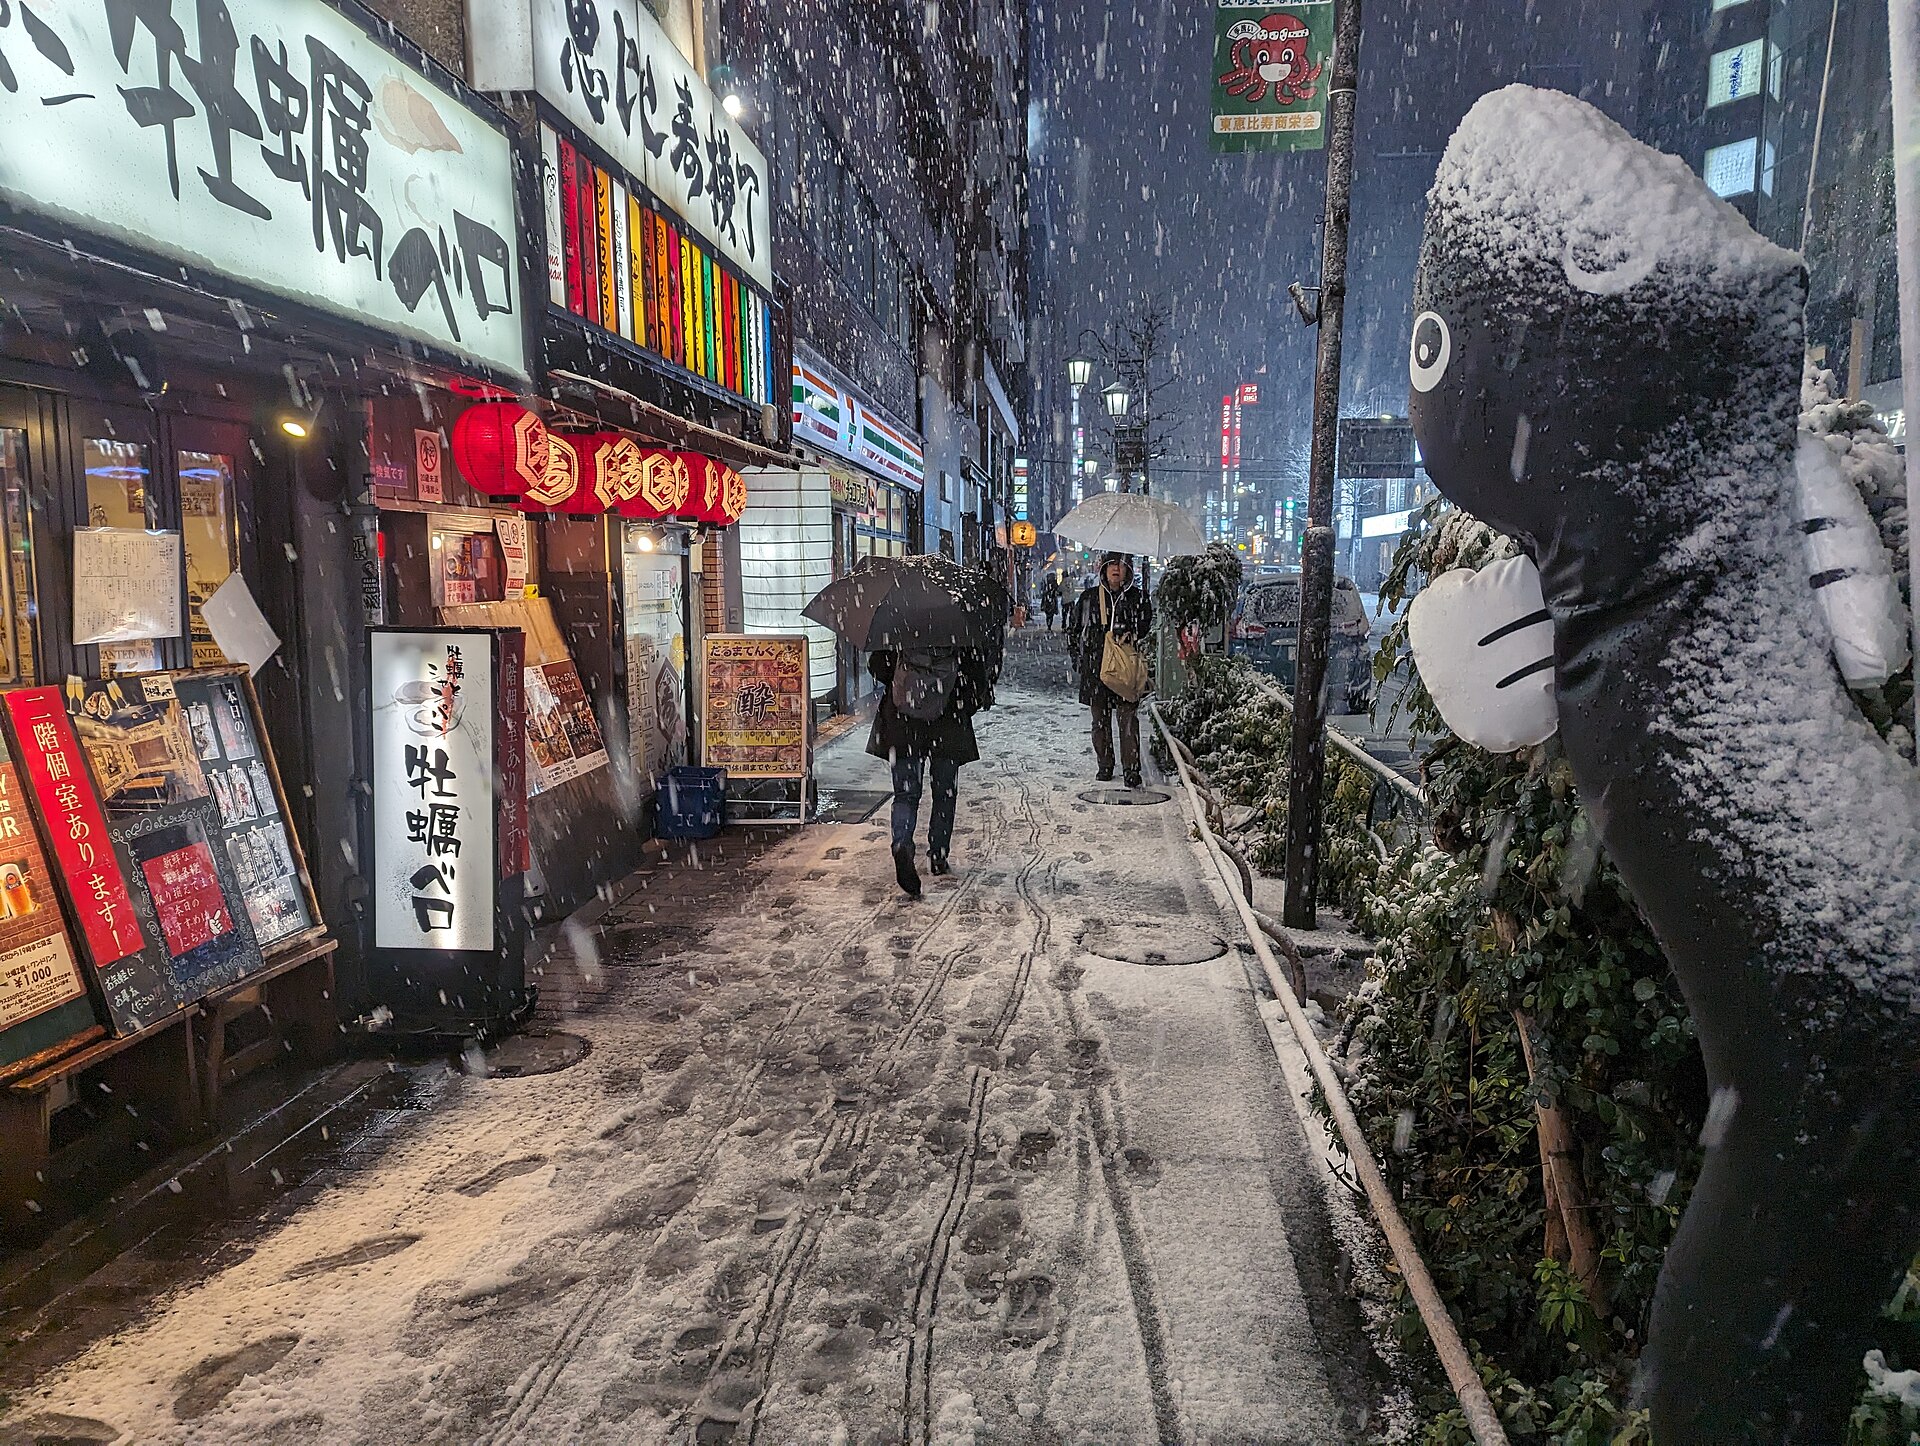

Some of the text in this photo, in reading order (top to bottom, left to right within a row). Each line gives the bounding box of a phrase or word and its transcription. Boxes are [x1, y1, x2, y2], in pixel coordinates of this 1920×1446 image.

[1219, 113, 1316, 131] 東恵比寿商栄会
[710, 645, 776, 657] だるまてんぐ
[25, 694, 124, 957] 二階個室あります!
[404, 744, 461, 933] 牡蠣ベロ
[174, 898, 200, 916] 本日の
